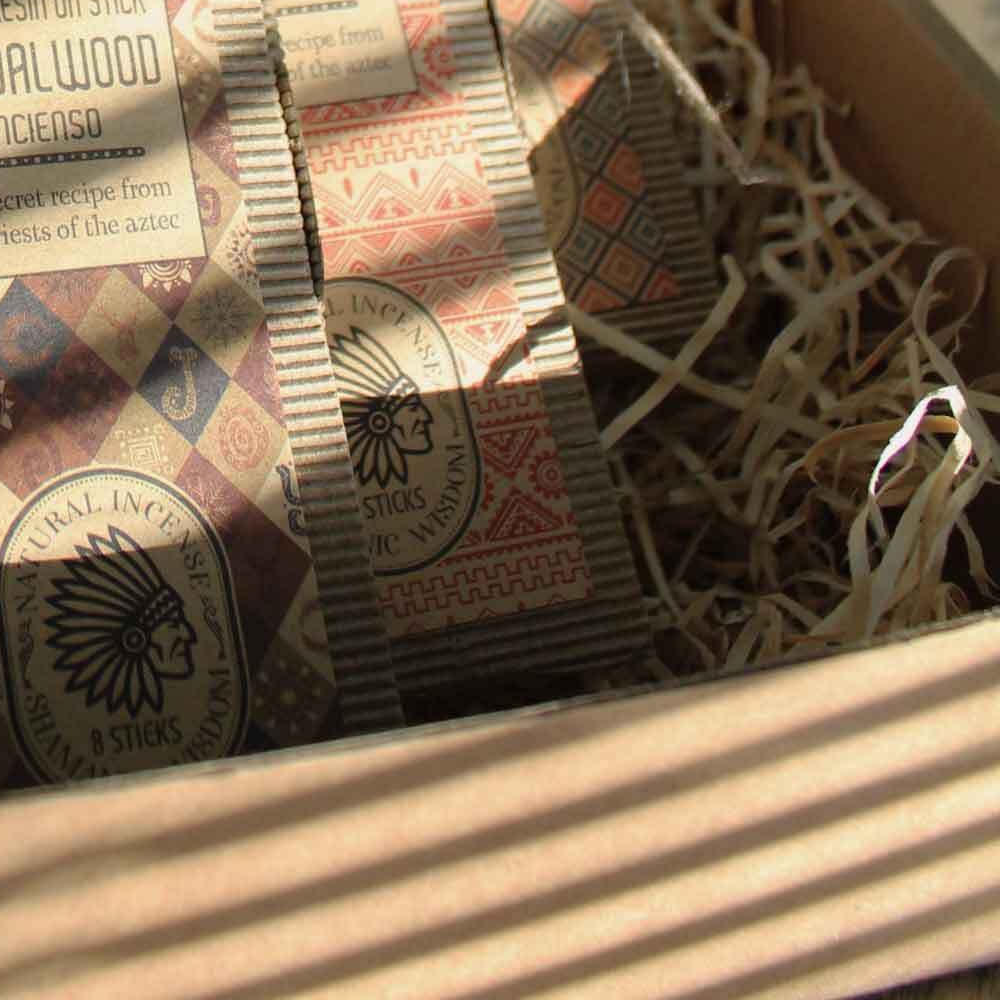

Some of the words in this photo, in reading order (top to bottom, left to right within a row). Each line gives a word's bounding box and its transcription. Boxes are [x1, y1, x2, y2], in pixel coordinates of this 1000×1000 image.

[50, 184, 117, 214] recipe
[121, 177, 173, 202] from
[57, 216, 83, 241] of
[85, 211, 121, 237] the
[125, 210, 181, 233] aztec
[351, 294, 442, 378] INCENSE
[362, 486, 427, 520] STICKS
[407, 443, 466, 545] WISDOM
[15, 489, 102, 614] NATURAL
[112, 488, 212, 590] INCENSE
[91, 729, 105, 756] 8
[109, 715, 184, 754] STICKS
